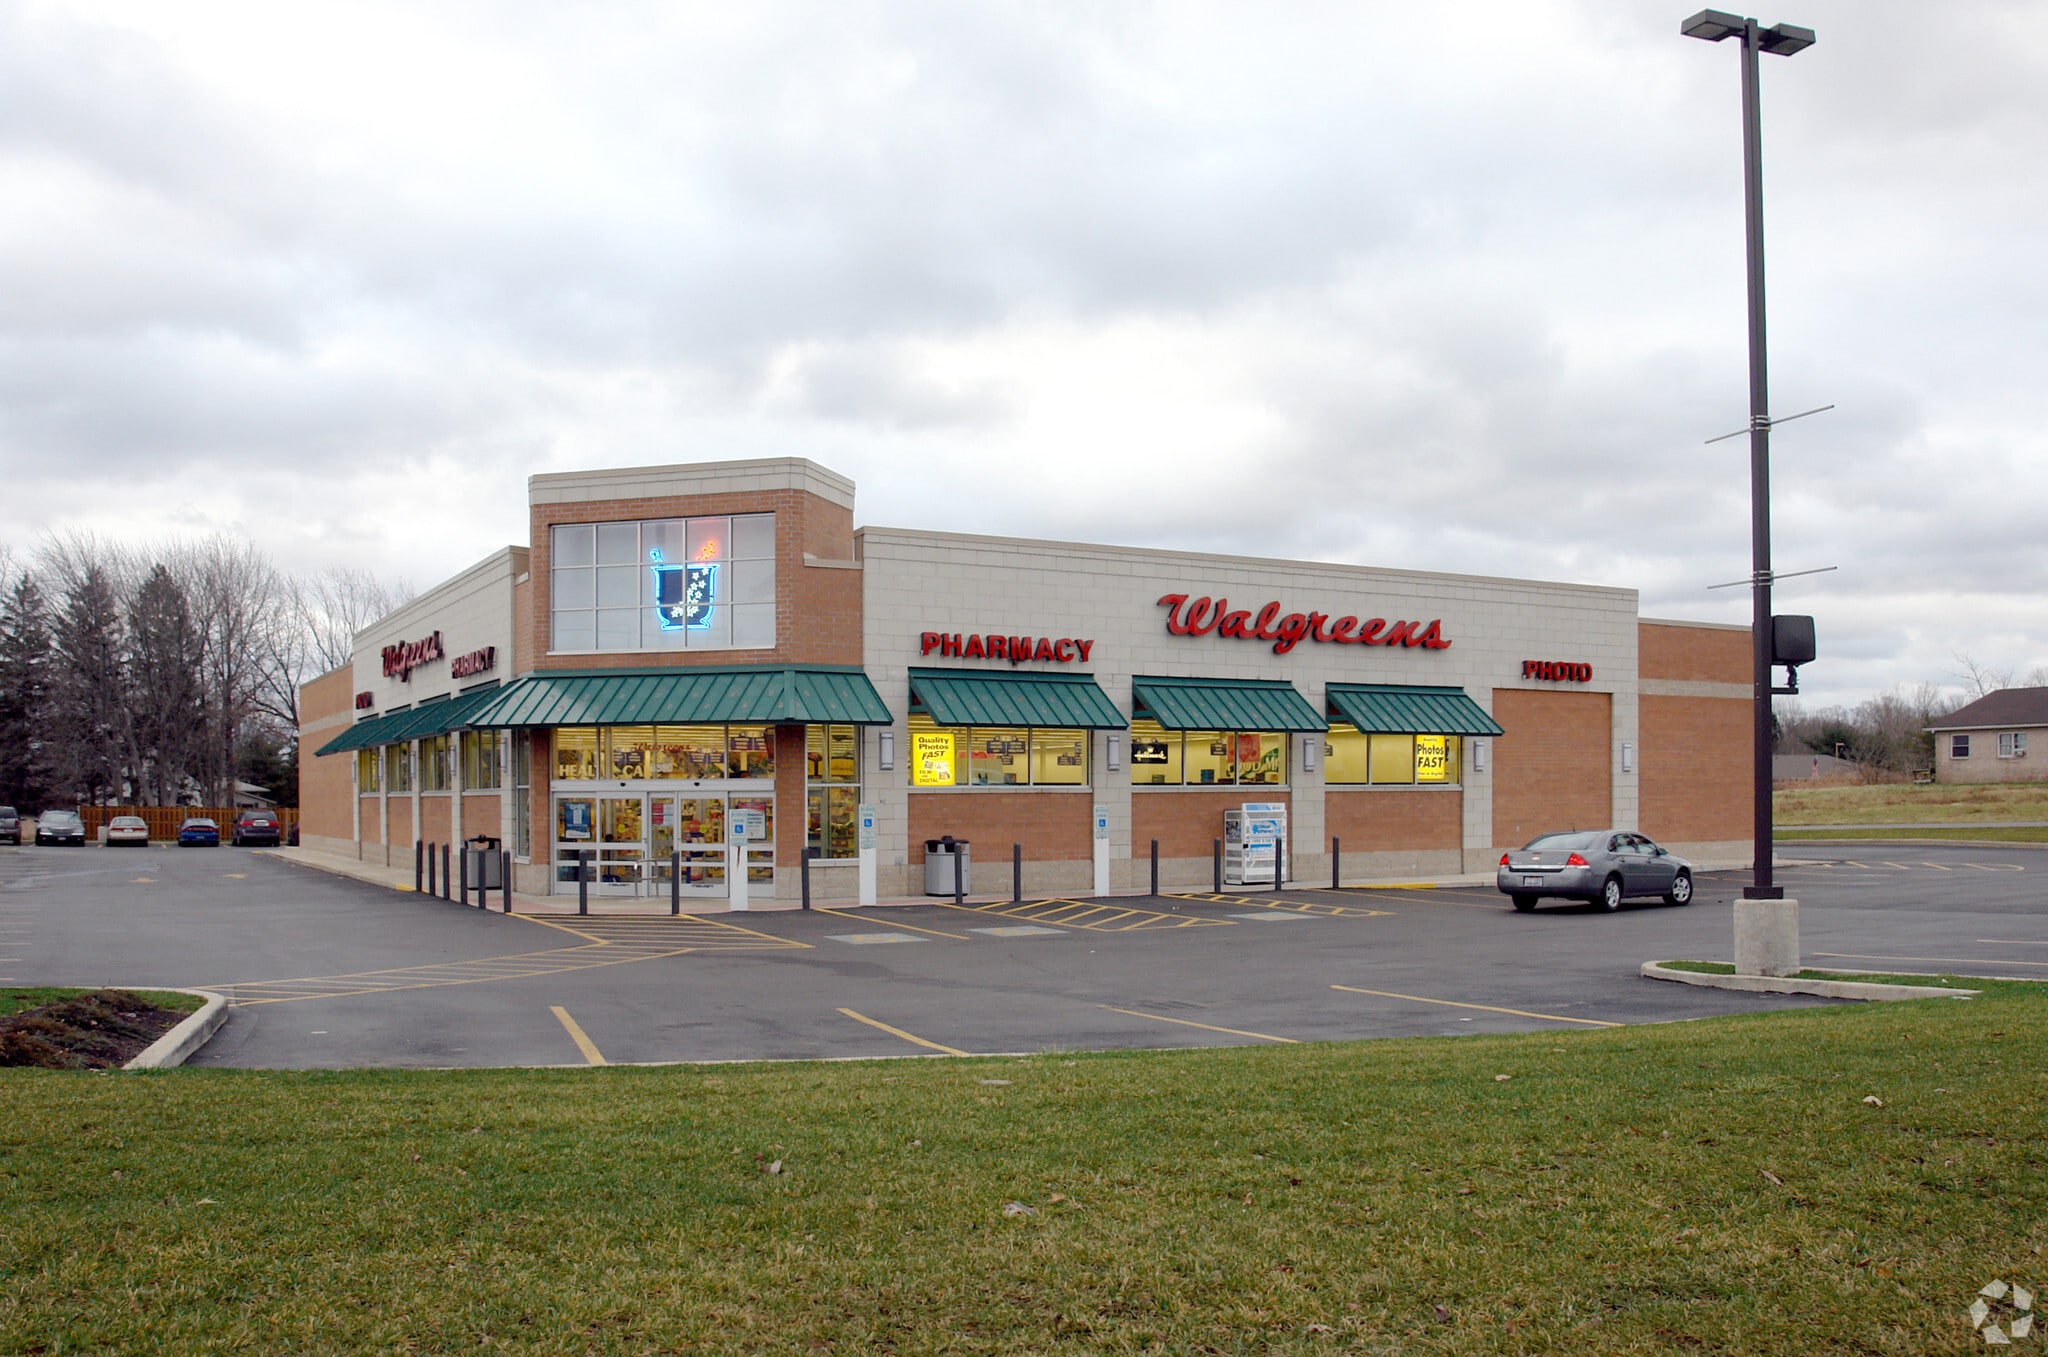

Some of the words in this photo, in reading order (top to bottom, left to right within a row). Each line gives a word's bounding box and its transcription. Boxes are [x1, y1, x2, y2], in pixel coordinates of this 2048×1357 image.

[1156, 594, 1451, 654] Walgreens
[921, 632, 1094, 663] PHARMACY
[451, 646, 497, 679] PHARMACY
[1522, 660, 1593, 682] PHOTO
[918, 736, 949, 744] Quality
[922, 750, 946, 760] FAST
[1417, 743, 1443, 755] Photos
[1418, 757, 1443, 768] FAST
[559, 764, 597, 777] HEAL
